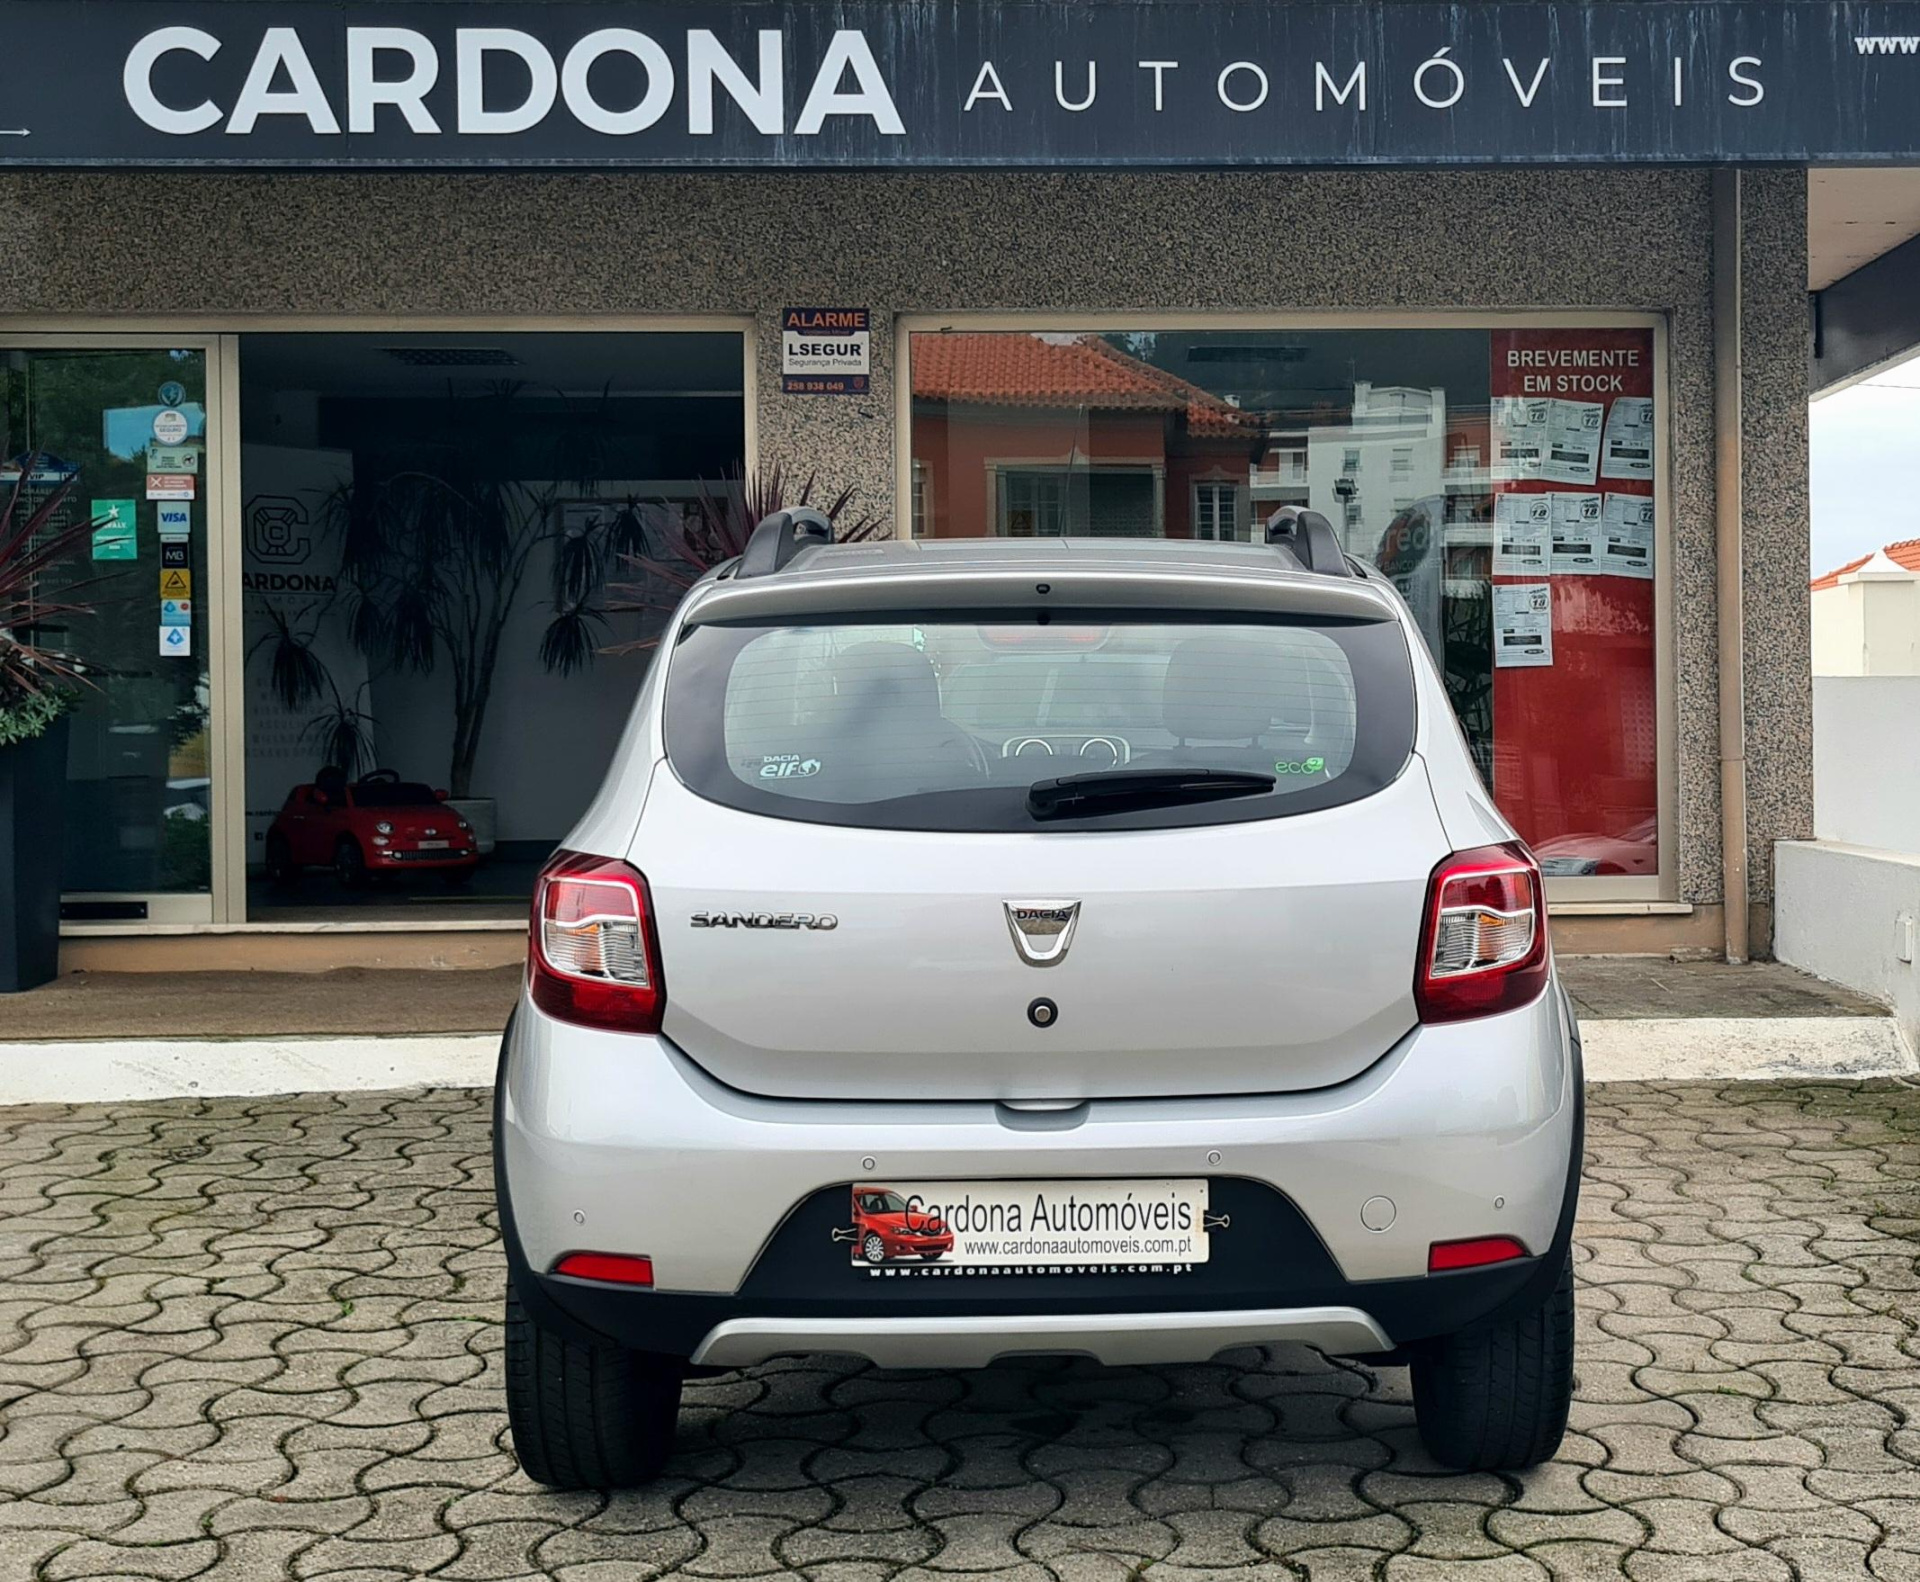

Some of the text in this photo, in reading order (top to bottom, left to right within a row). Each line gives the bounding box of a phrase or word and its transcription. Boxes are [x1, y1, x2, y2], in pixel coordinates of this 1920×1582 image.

[123, 26, 1765, 136] CARDONA AUTOMÓVEIS
[787, 312, 866, 328] ALARME
[788, 343, 862, 356] LSEGUR
[788, 358, 862, 368] Segurança Privada
[1507, 349, 1639, 368] BREVEMENTE
[1523, 374, 1623, 393] EM STOCK
[160, 511, 187, 523] VISA
[165, 550, 184, 561] MB
[243, 572, 337, 592] ARDONA
[763, 754, 800, 763] DACIA
[759, 761, 799, 777] elf
[690, 911, 839, 930] SANDERO
[1017, 910, 1068, 920] DACIA
[904, 1191, 1192, 1234] Cardona Automóveis
[964, 1235, 1192, 1258] www.cardonaautomoveis.com.pt
[869, 1263, 1193, 1277] www.cardonaautomoveis.com.pt
